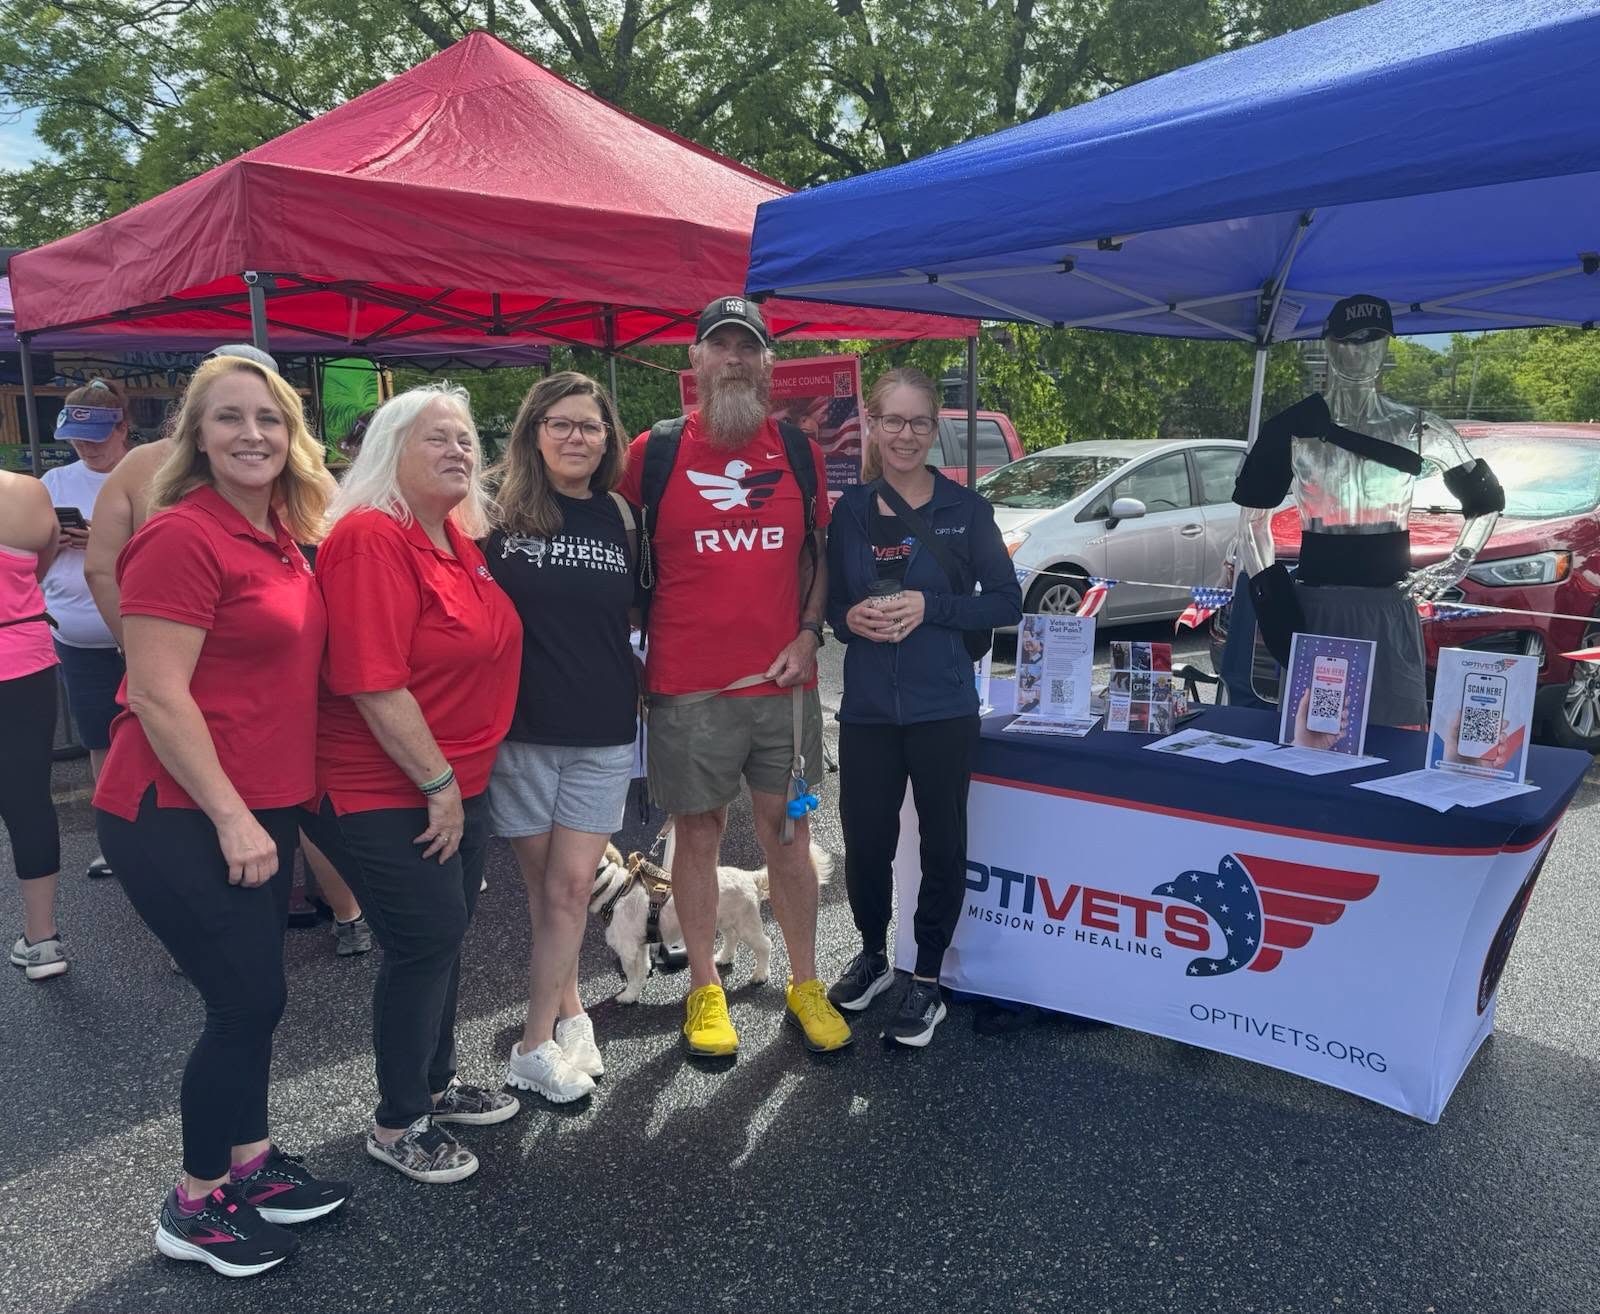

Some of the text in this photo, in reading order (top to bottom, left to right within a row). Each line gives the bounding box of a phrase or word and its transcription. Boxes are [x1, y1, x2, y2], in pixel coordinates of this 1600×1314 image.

[1345, 304, 1384, 320] NAVY
[798, 375, 832, 386] COUNCIL
[720, 519, 760, 528] TEAM
[551, 535, 603, 547] PUTTING
[694, 527, 785, 553] RWB
[551, 542, 626, 567] PIECES
[874, 544, 912, 557] VETS
[550, 557, 628, 575] BACK TOGETHER
[1049, 619, 1082, 627] Veteran?
[1063, 626, 1083, 634] Pain?
[1315, 665, 1345, 677] SCAN HERE
[1461, 660, 1501, 670] OPTIVETS
[1467, 684, 1503, 697] SCAN HERE
[966, 859, 1211, 951] PTIVETS
[968, 904, 1163, 959] MISSION OF HEALING
[1189, 1003, 1388, 1073] OPTIVETS.ORG
